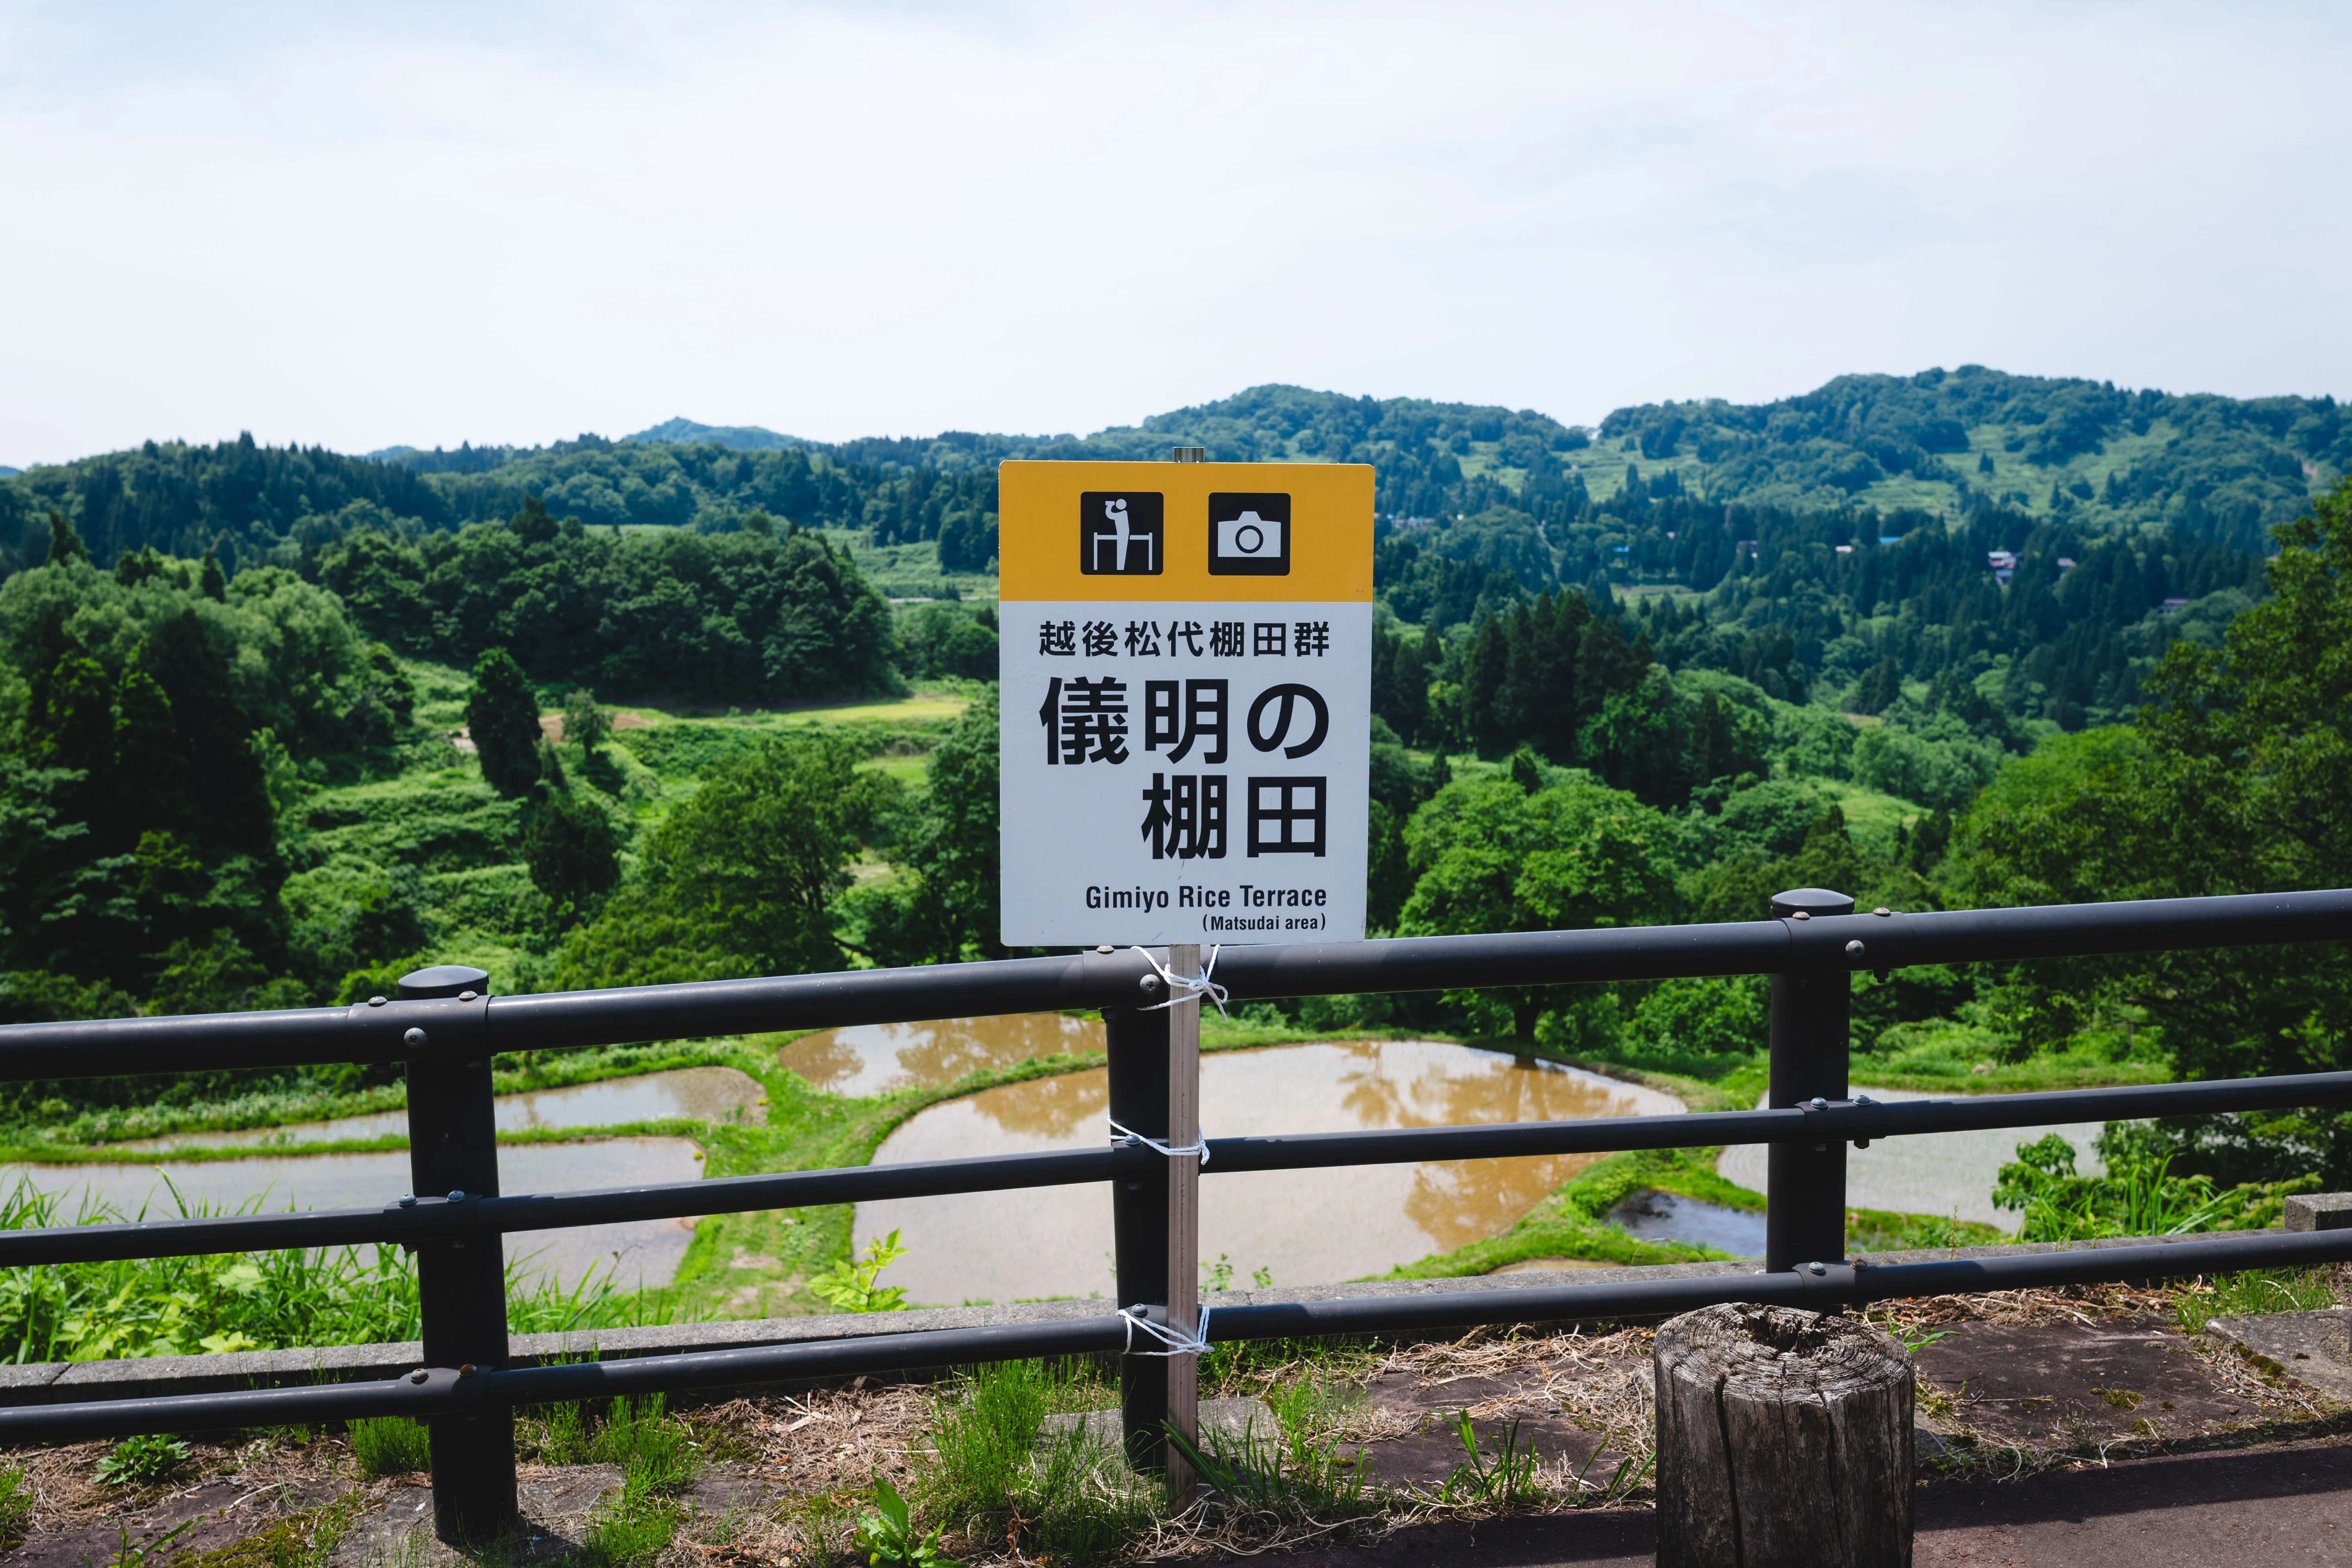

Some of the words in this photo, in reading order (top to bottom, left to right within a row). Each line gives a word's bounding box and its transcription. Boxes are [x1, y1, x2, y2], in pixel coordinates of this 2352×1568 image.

[1039, 621, 1329, 657] 越後松代棚田群
[1039, 676, 1329, 765] 儀明の
[1141, 773, 1327, 860] 棚田
[1086, 886, 1168, 913] Gimiyo
[1179, 885, 1230, 907] Rice
[1240, 885, 1326, 907] Terrace
[1203, 914, 1279, 932] (Matsudai
[1285, 913, 1326, 931] area)
